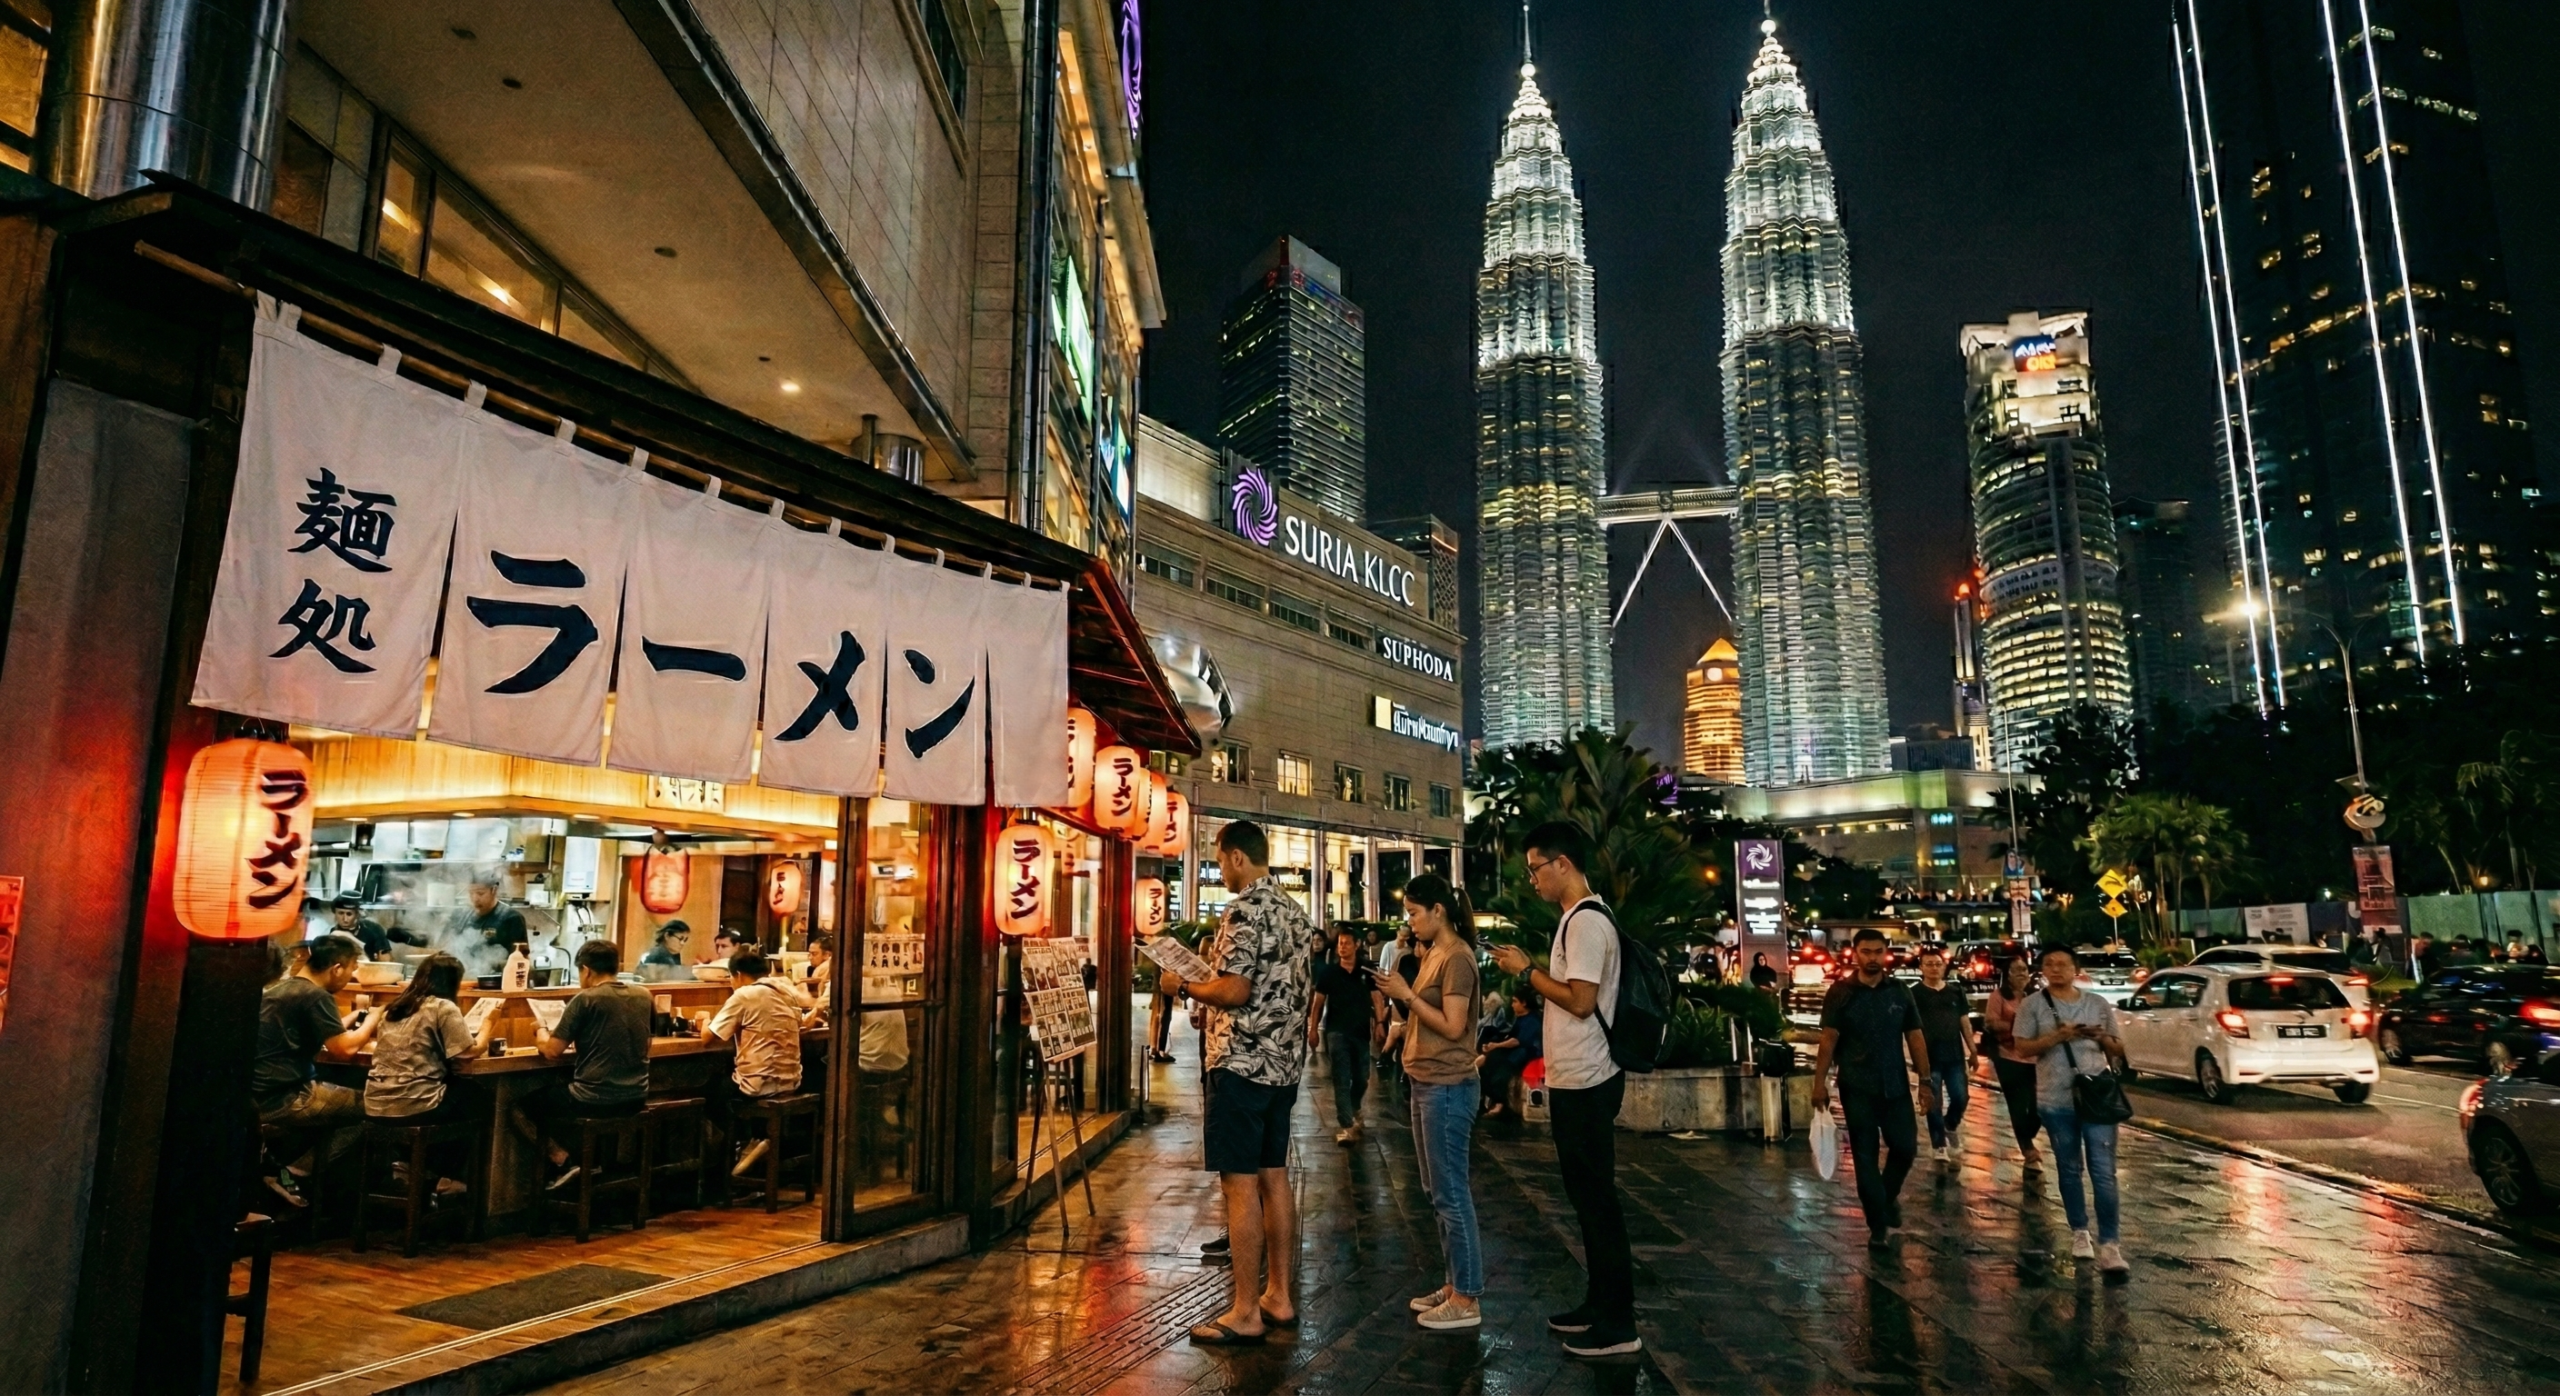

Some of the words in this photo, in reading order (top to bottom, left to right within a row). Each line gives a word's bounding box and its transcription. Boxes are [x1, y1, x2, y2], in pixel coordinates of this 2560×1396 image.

[268, 467, 397, 673] 麺処
[1284, 515, 1360, 586] SURIA
[1364, 550, 1415, 607] KLCC
[467, 550, 975, 759] ラーメン
[1382, 636, 1454, 682] SUPHODA
[1112, 757, 1134, 817] ラーメン
[245, 769, 309, 910] ラーメン
[1010, 838, 1041, 920] ラーメン
[1149, 888, 1163, 926] ラーメン
